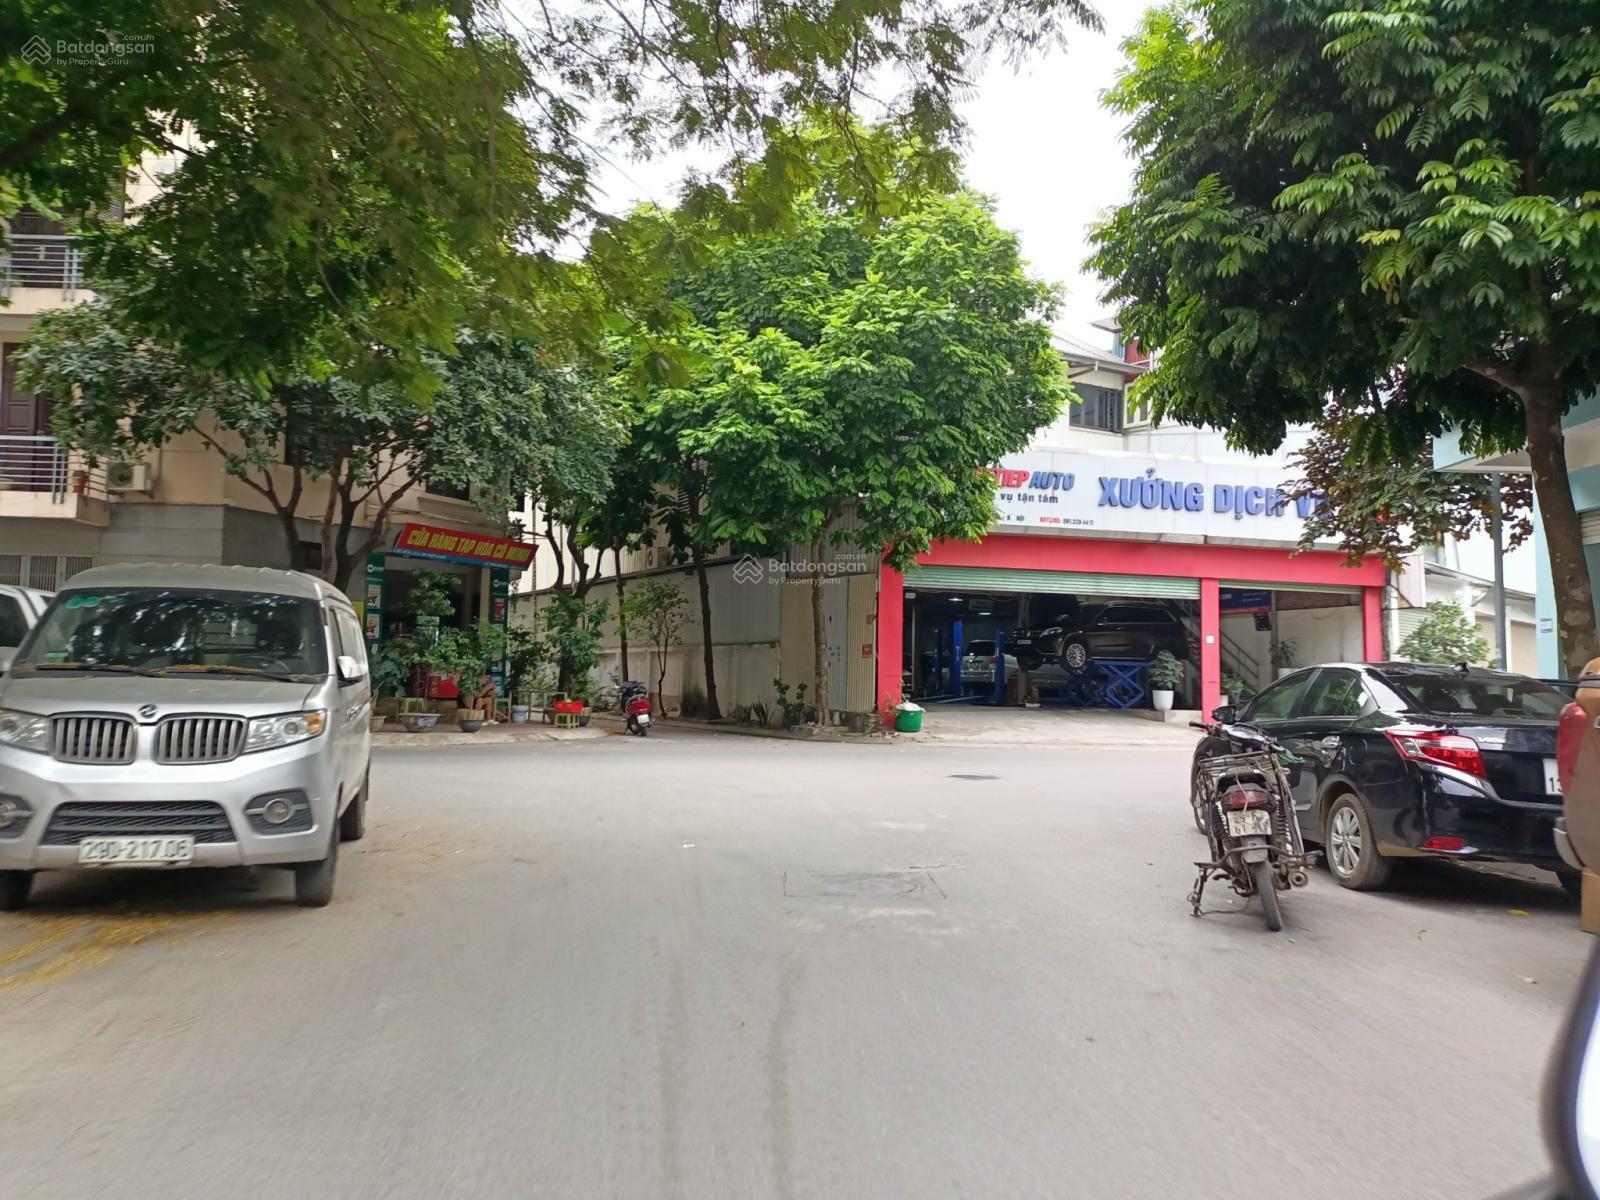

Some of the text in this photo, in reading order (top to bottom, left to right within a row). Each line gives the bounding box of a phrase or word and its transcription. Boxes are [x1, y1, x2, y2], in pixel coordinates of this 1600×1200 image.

[1029, 470, 1075, 491] AUTO
[1000, 492, 1013, 503] vụ
[1018, 492, 1035, 504] tận
[1098, 467, 1204, 512] XƯỞNG
[1213, 483, 1285, 521] DỊCH
